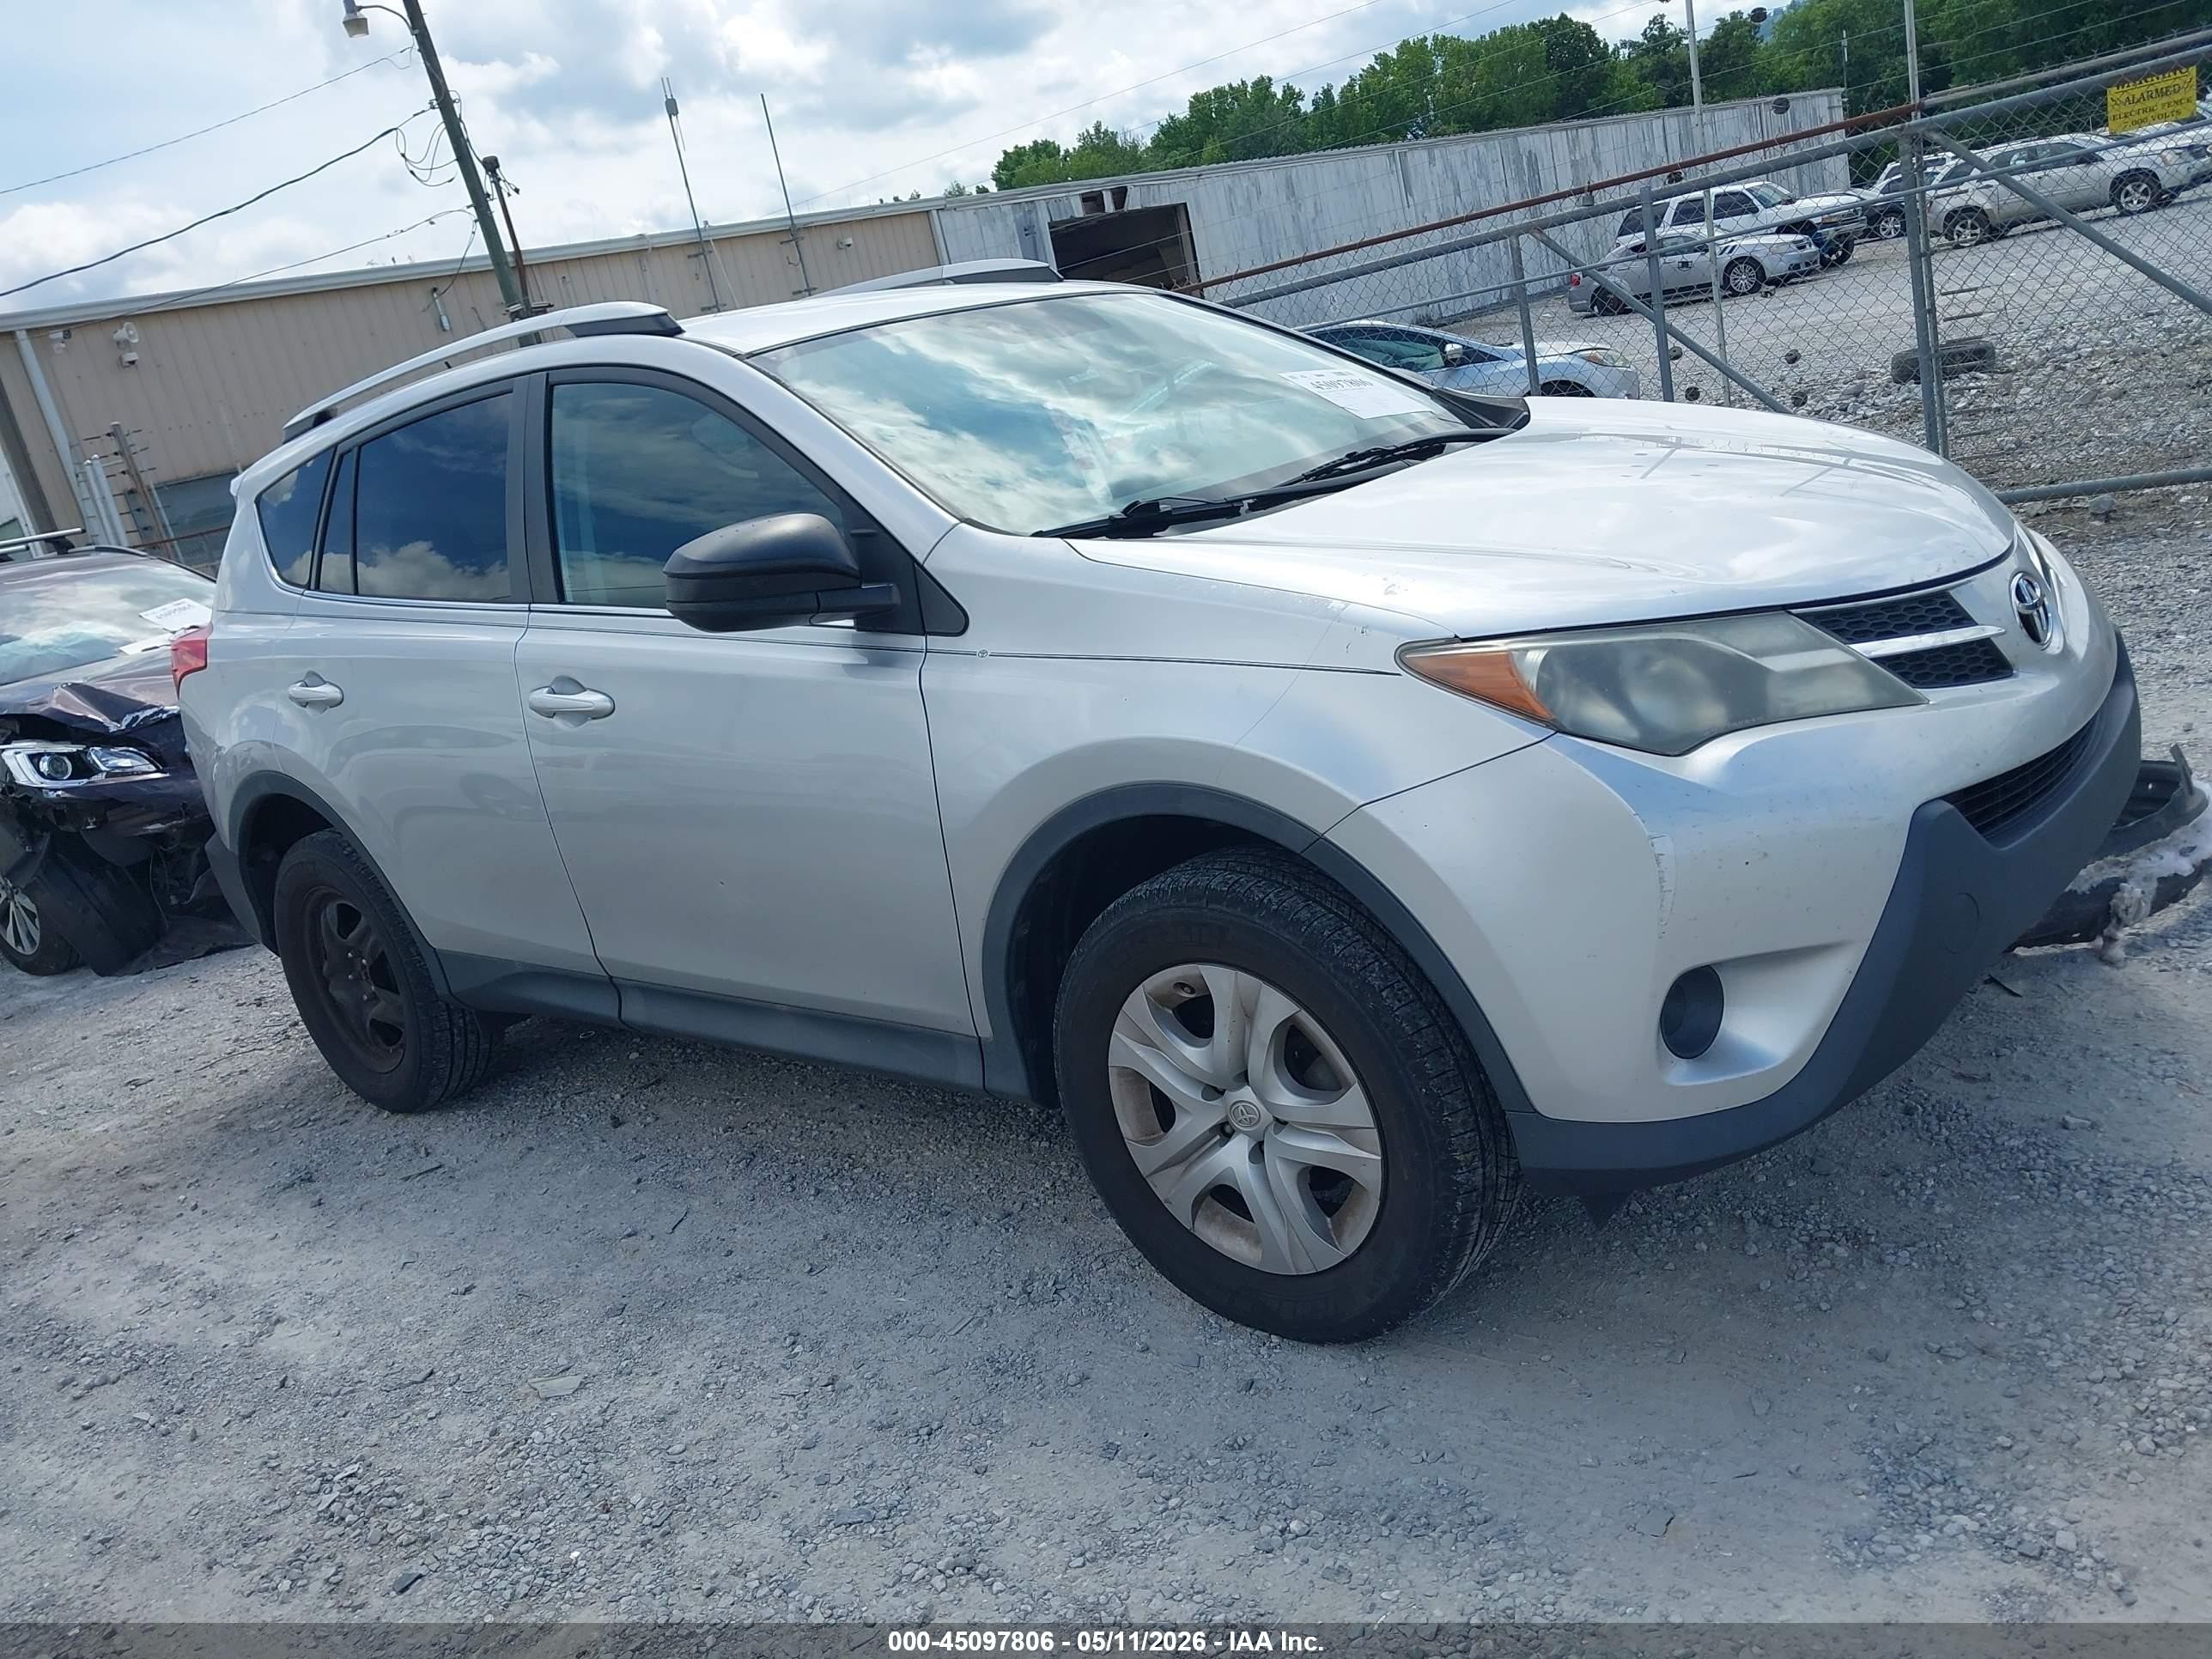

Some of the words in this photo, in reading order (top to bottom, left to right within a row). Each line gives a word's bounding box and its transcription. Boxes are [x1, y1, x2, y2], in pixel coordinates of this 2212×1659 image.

[2124, 83, 2181, 106] ALARMED
[2112, 105, 2158, 121] ELECTRIC
[2161, 96, 2192, 110] FENCE
[2150, 110, 2182, 122] VOLTS
